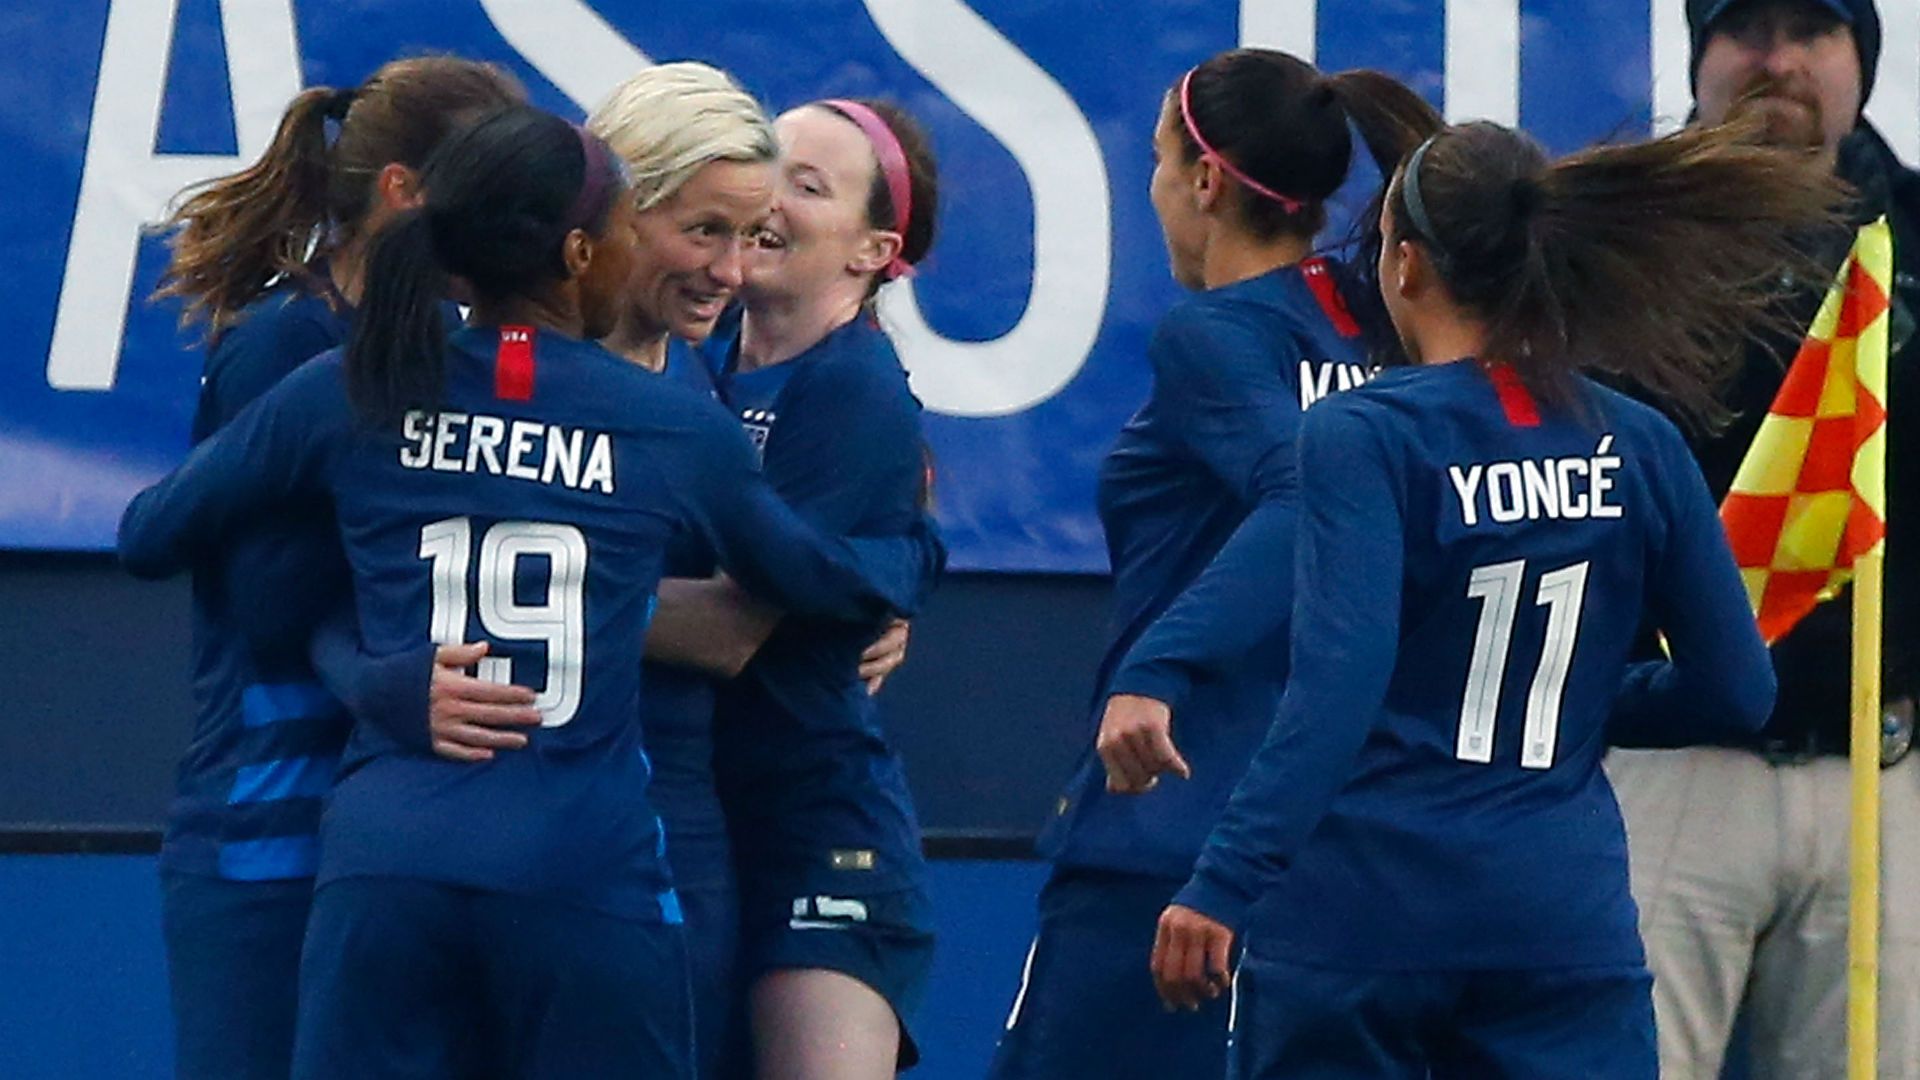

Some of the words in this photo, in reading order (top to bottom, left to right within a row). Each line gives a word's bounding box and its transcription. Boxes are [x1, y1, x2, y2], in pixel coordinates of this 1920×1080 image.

[400, 410, 614, 493] SERENA
[1449, 434, 1623, 525] YONCÉ
[419, 516, 588, 728] 19
[1456, 559, 1590, 769] 11
